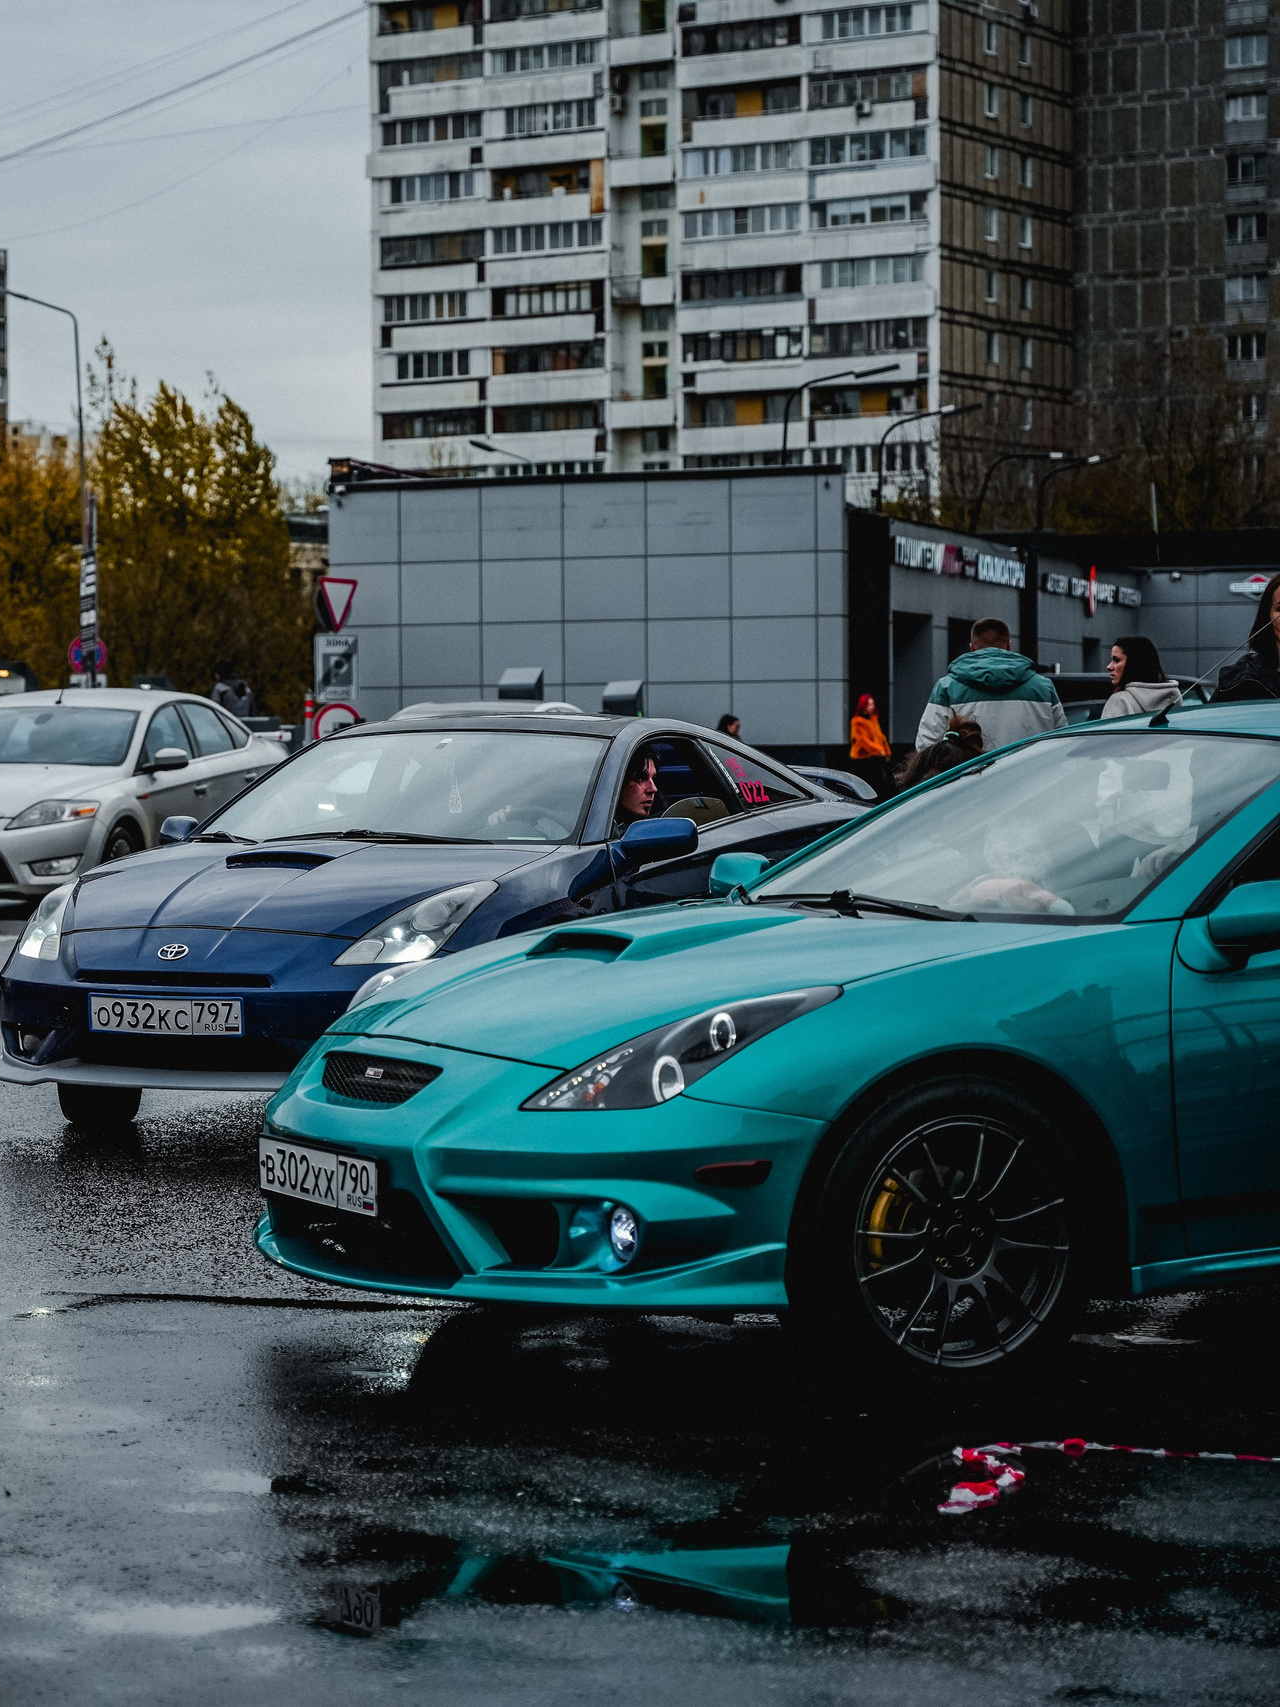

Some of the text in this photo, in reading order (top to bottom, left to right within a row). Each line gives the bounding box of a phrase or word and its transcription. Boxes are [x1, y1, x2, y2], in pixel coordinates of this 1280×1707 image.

[739, 780, 769, 803] 022
[194, 1002, 233, 1024] 797
[265, 1148, 370, 1200] B302XX 790
[347, 1194, 362, 1208] RUS
